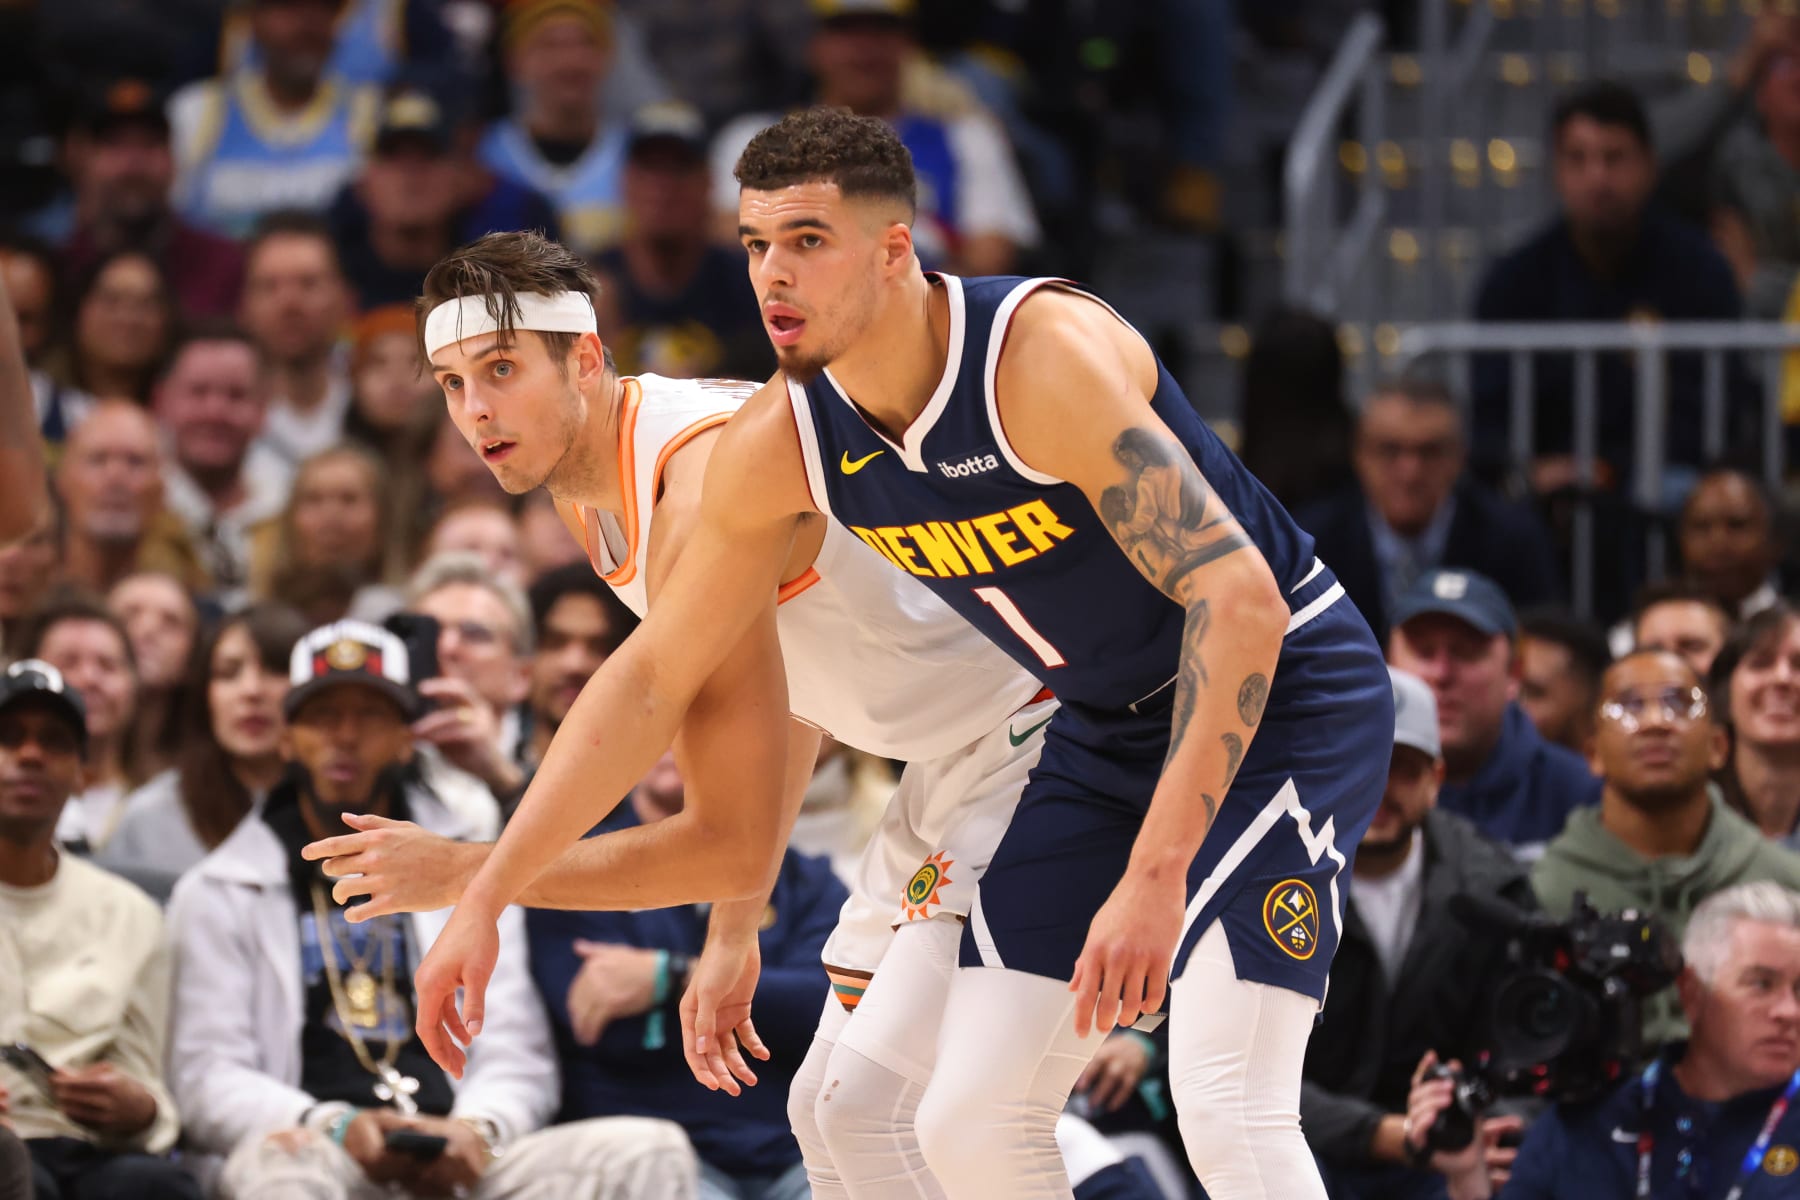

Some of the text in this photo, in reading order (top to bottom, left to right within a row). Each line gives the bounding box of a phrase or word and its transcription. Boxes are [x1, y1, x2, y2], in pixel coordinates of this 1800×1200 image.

[937, 454, 999, 478] ibotta
[849, 498, 1076, 577] DENVER
[970, 586, 1069, 670] 1
